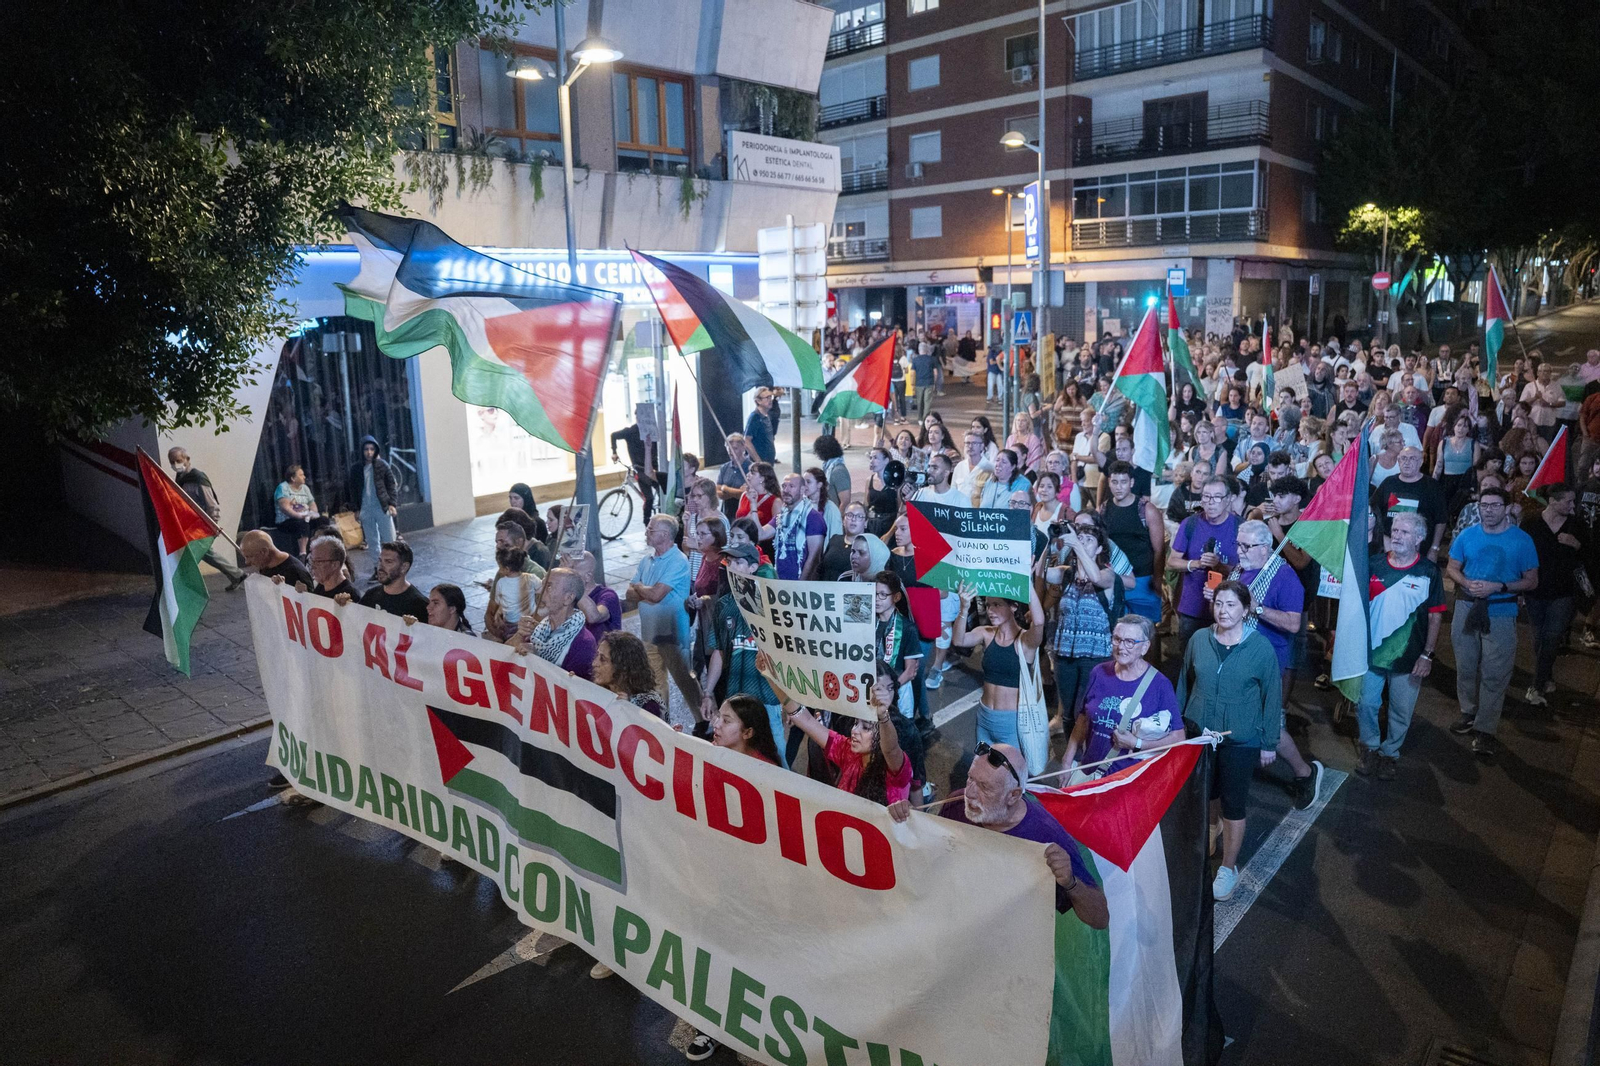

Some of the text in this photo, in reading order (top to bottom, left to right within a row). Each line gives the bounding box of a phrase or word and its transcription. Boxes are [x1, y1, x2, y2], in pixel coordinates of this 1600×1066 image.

[741, 140, 782, 153] PERIODONCIA
[789, 147, 833, 160] IMPLANTOLOGÍA
[765, 156, 813, 170] ESTÉTICA DENTAL
[784, 172, 791, 180] 77
[511, 261, 587, 285] VISION
[934, 507, 1009, 521] HAY QUE HACER
[957, 540, 1009, 551] CUANDO LOS
[986, 556, 1021, 565] DUERMEN
[957, 569, 1012, 580] NO CUANDO
[976, 581, 1021, 597] MATAN
[766, 585, 836, 612] DONDE
[770, 608, 842, 634] ESTAN
[750, 623, 875, 662] OS DERECHOS
[281, 595, 896, 890] NO AL GENOCIDIO
[277, 721, 501, 874] SOLIDARIDAD
[503, 843, 596, 947] CON
